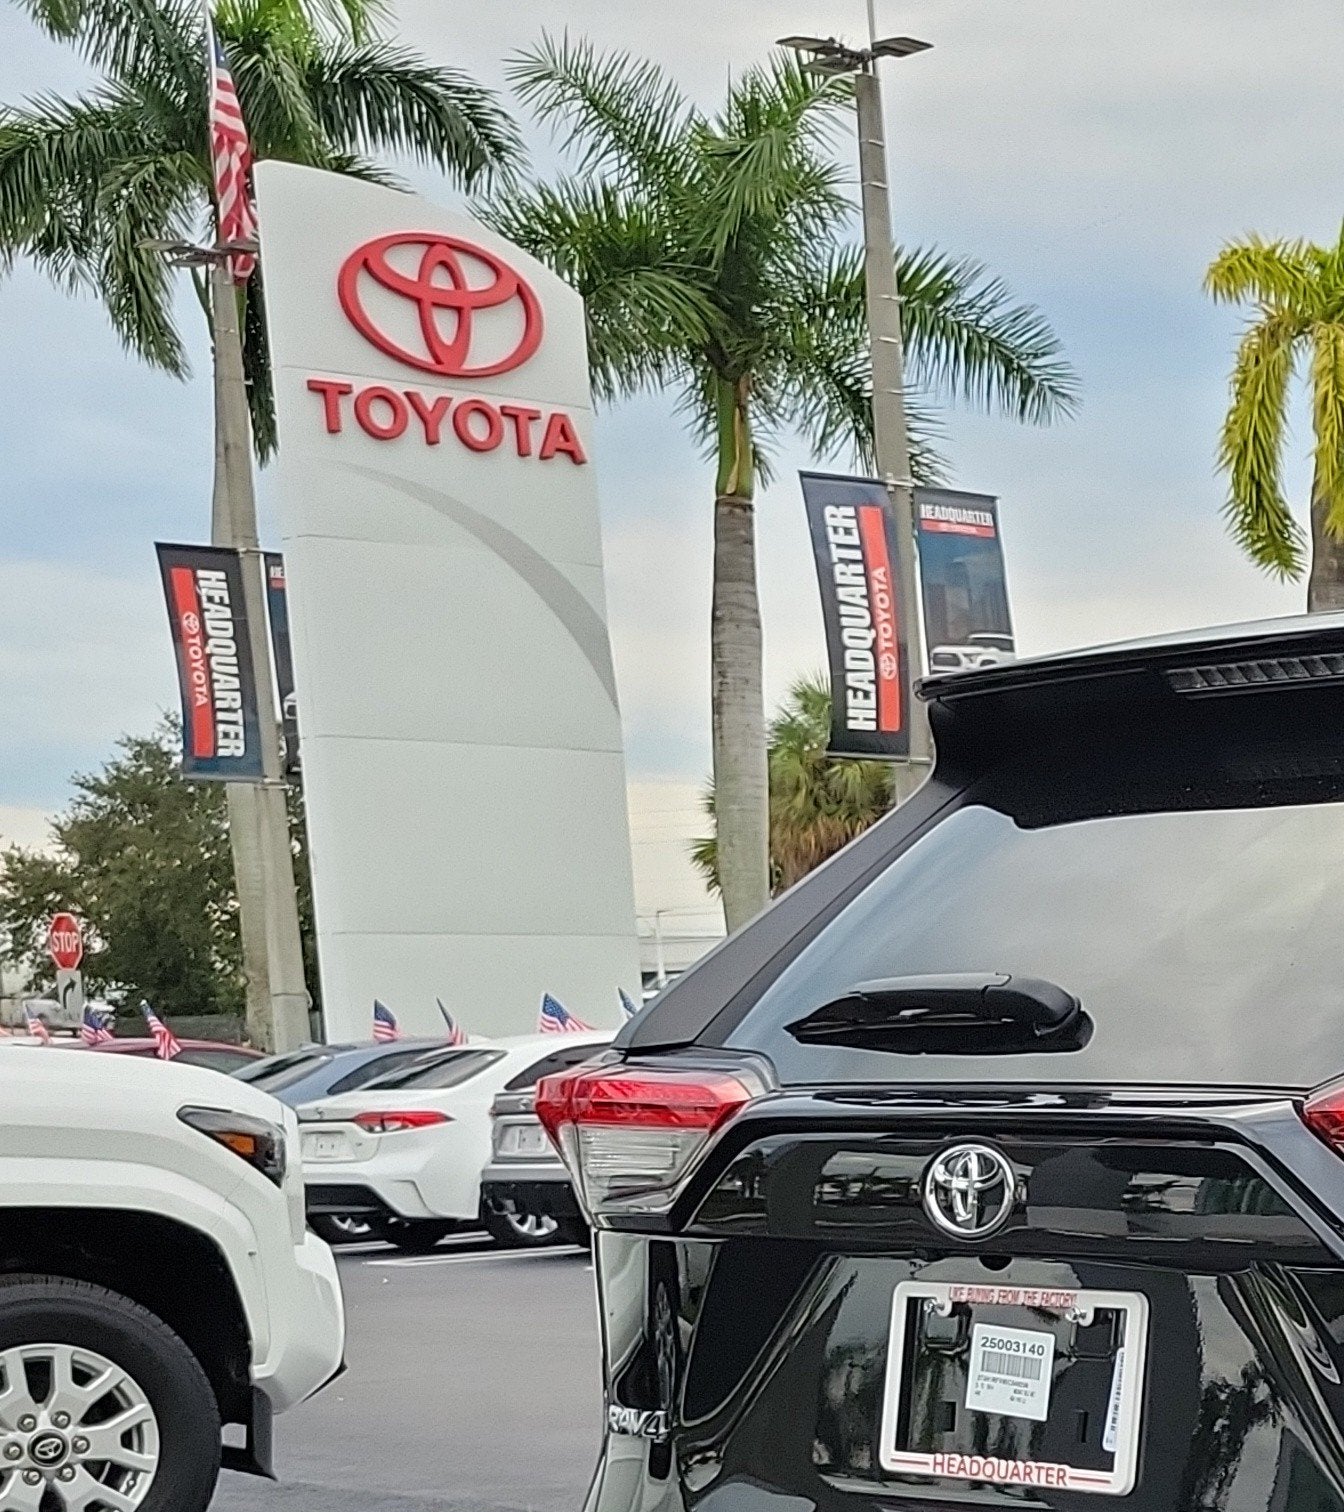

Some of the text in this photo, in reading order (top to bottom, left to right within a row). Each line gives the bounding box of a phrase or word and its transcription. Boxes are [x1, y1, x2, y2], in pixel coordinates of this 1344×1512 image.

[306, 379, 588, 465] TOYOTA
[920, 503, 993, 527] HEADQUARTER
[824, 504, 877, 732] HEADQUARTER
[872, 567, 895, 651] TOYOTA
[187, 636, 208, 707] TOYOTA
[196, 569, 245, 757] HEADQUARTER
[52, 931, 79, 953] STOP
[998, 1289, 1020, 1305] FROM
[1023, 1290, 1039, 1306] THE
[981, 1336, 1045, 1356] 25003140
[609, 1404, 670, 1443] RAV4
[932, 1456, 1067, 1486] HEADQUARTER
